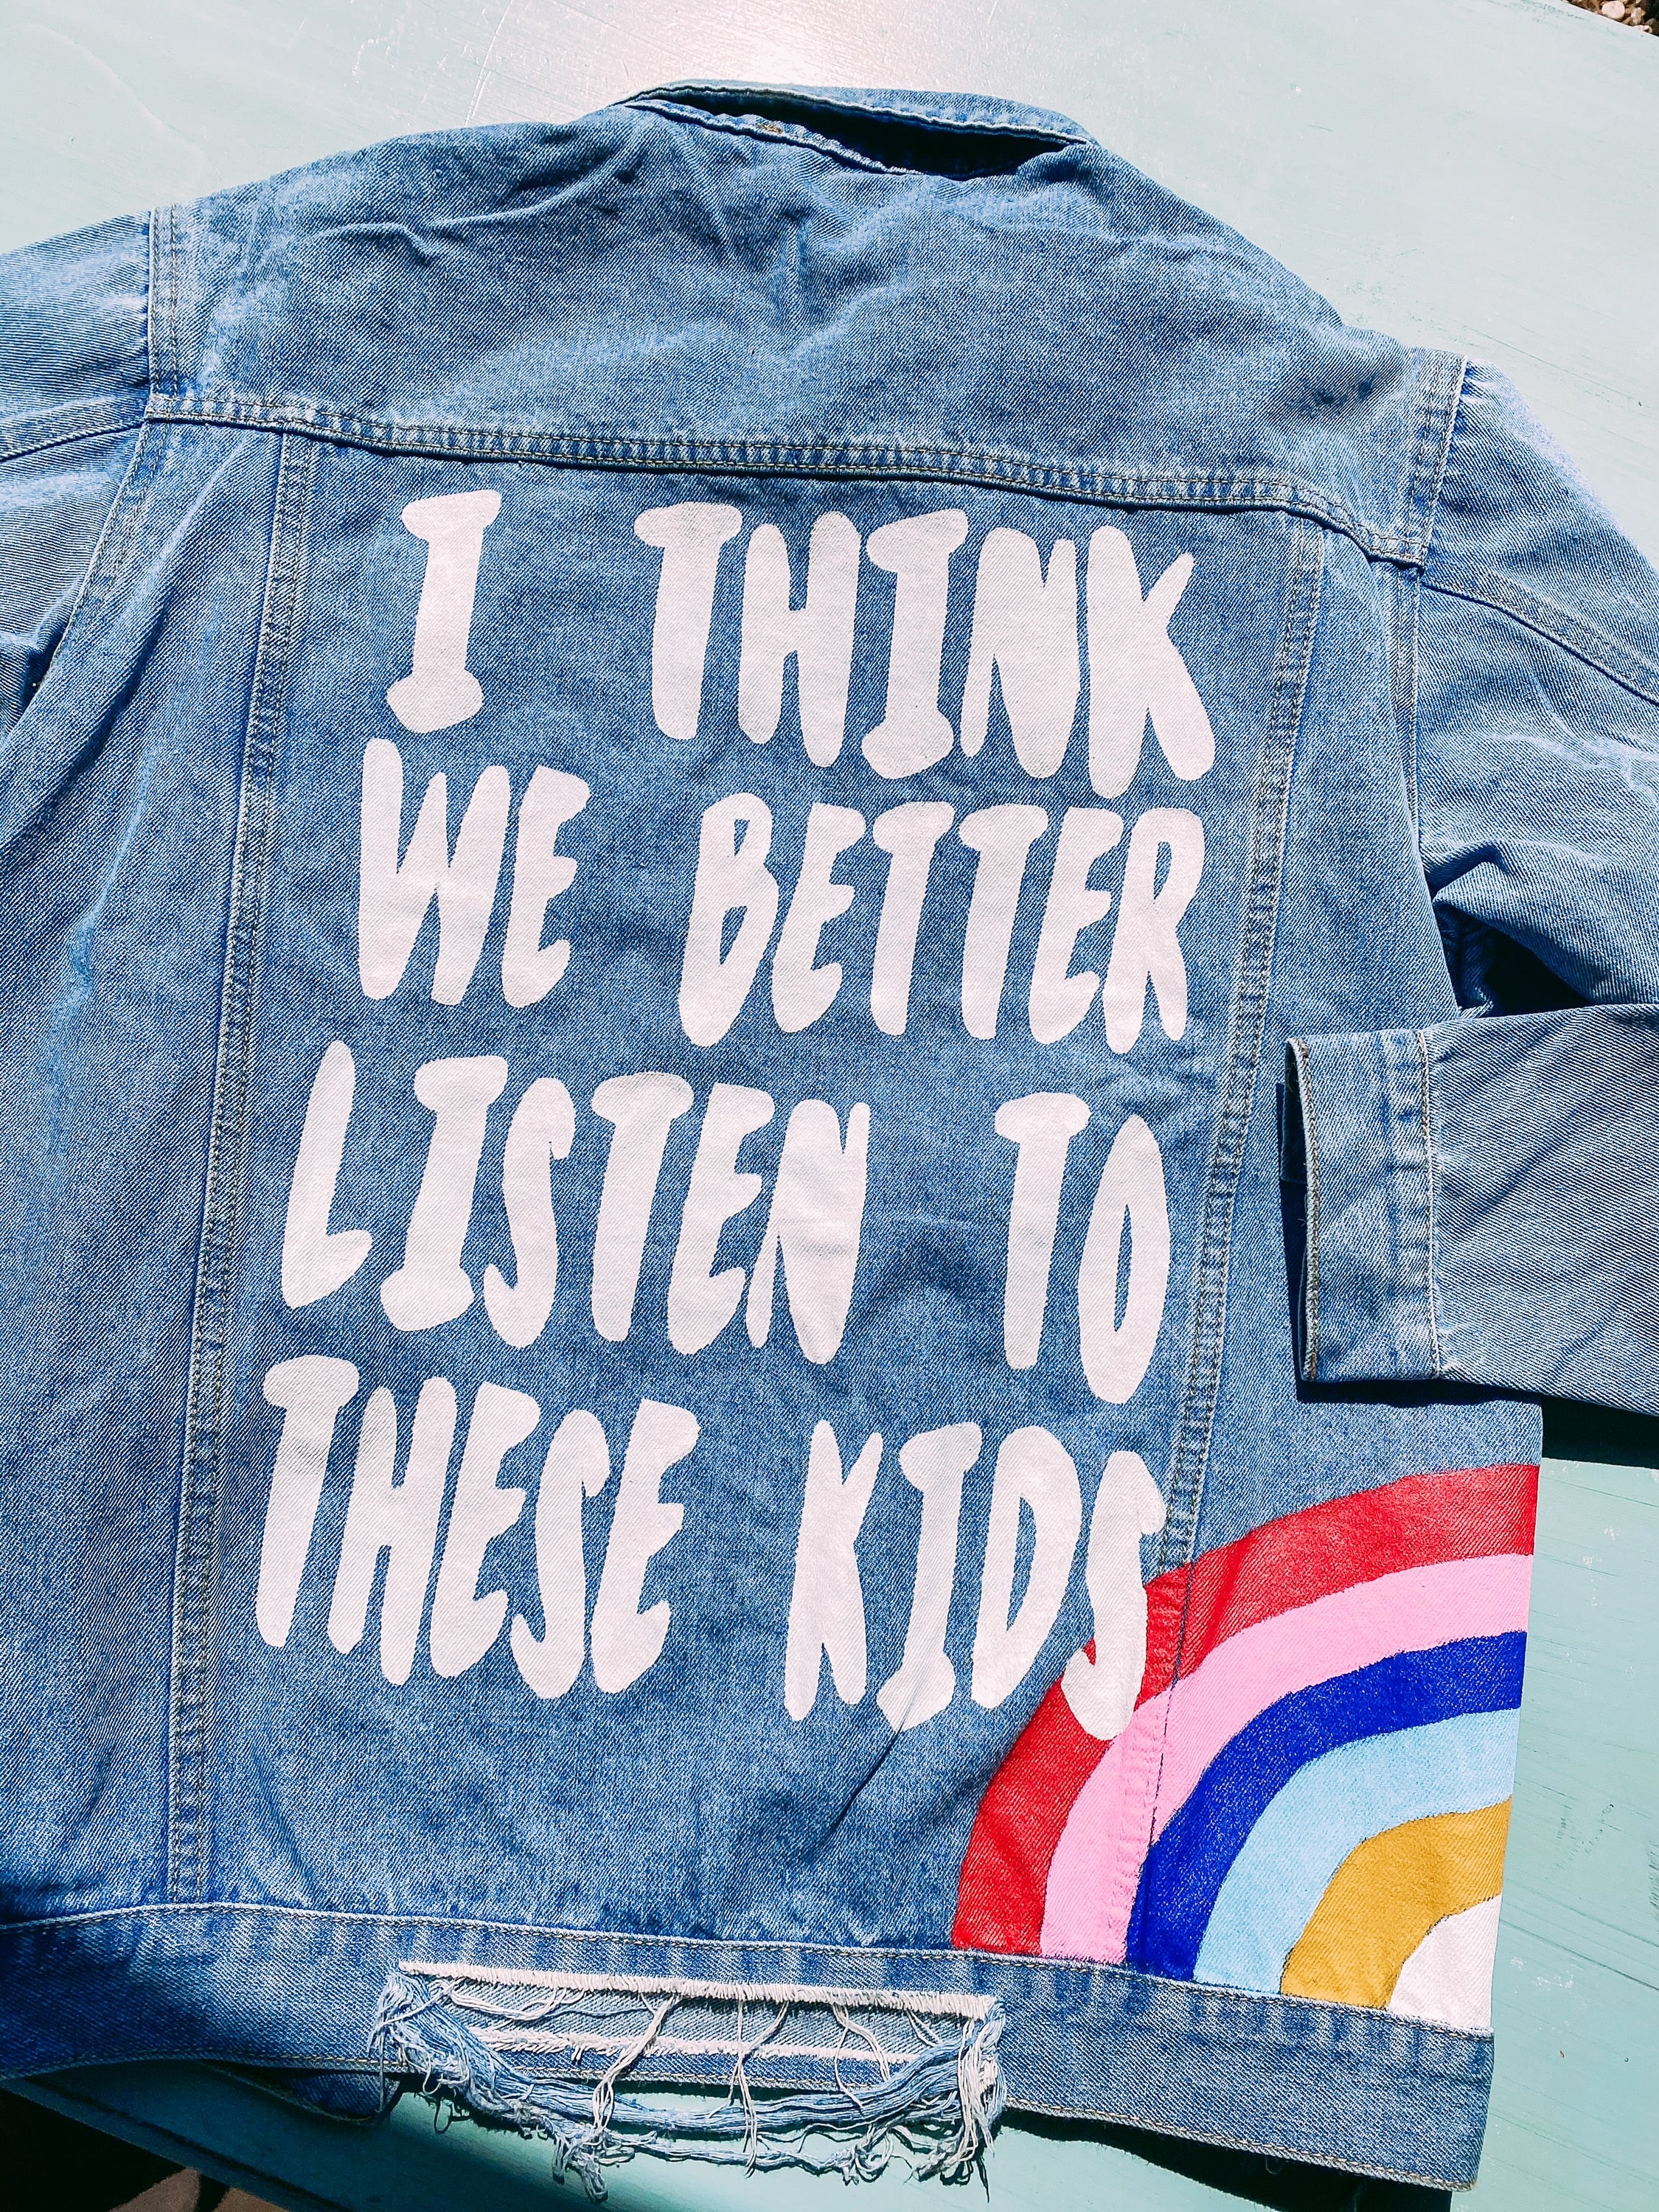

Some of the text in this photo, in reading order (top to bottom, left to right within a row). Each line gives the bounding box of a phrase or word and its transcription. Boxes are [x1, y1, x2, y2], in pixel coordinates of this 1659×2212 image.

[386, 489, 1216, 799] I THINK
[358, 738, 1205, 1054] WE BETTER
[281, 1040, 1171, 1405] LISTEN TO
[256, 1354, 1167, 1741] THESE KIDS
